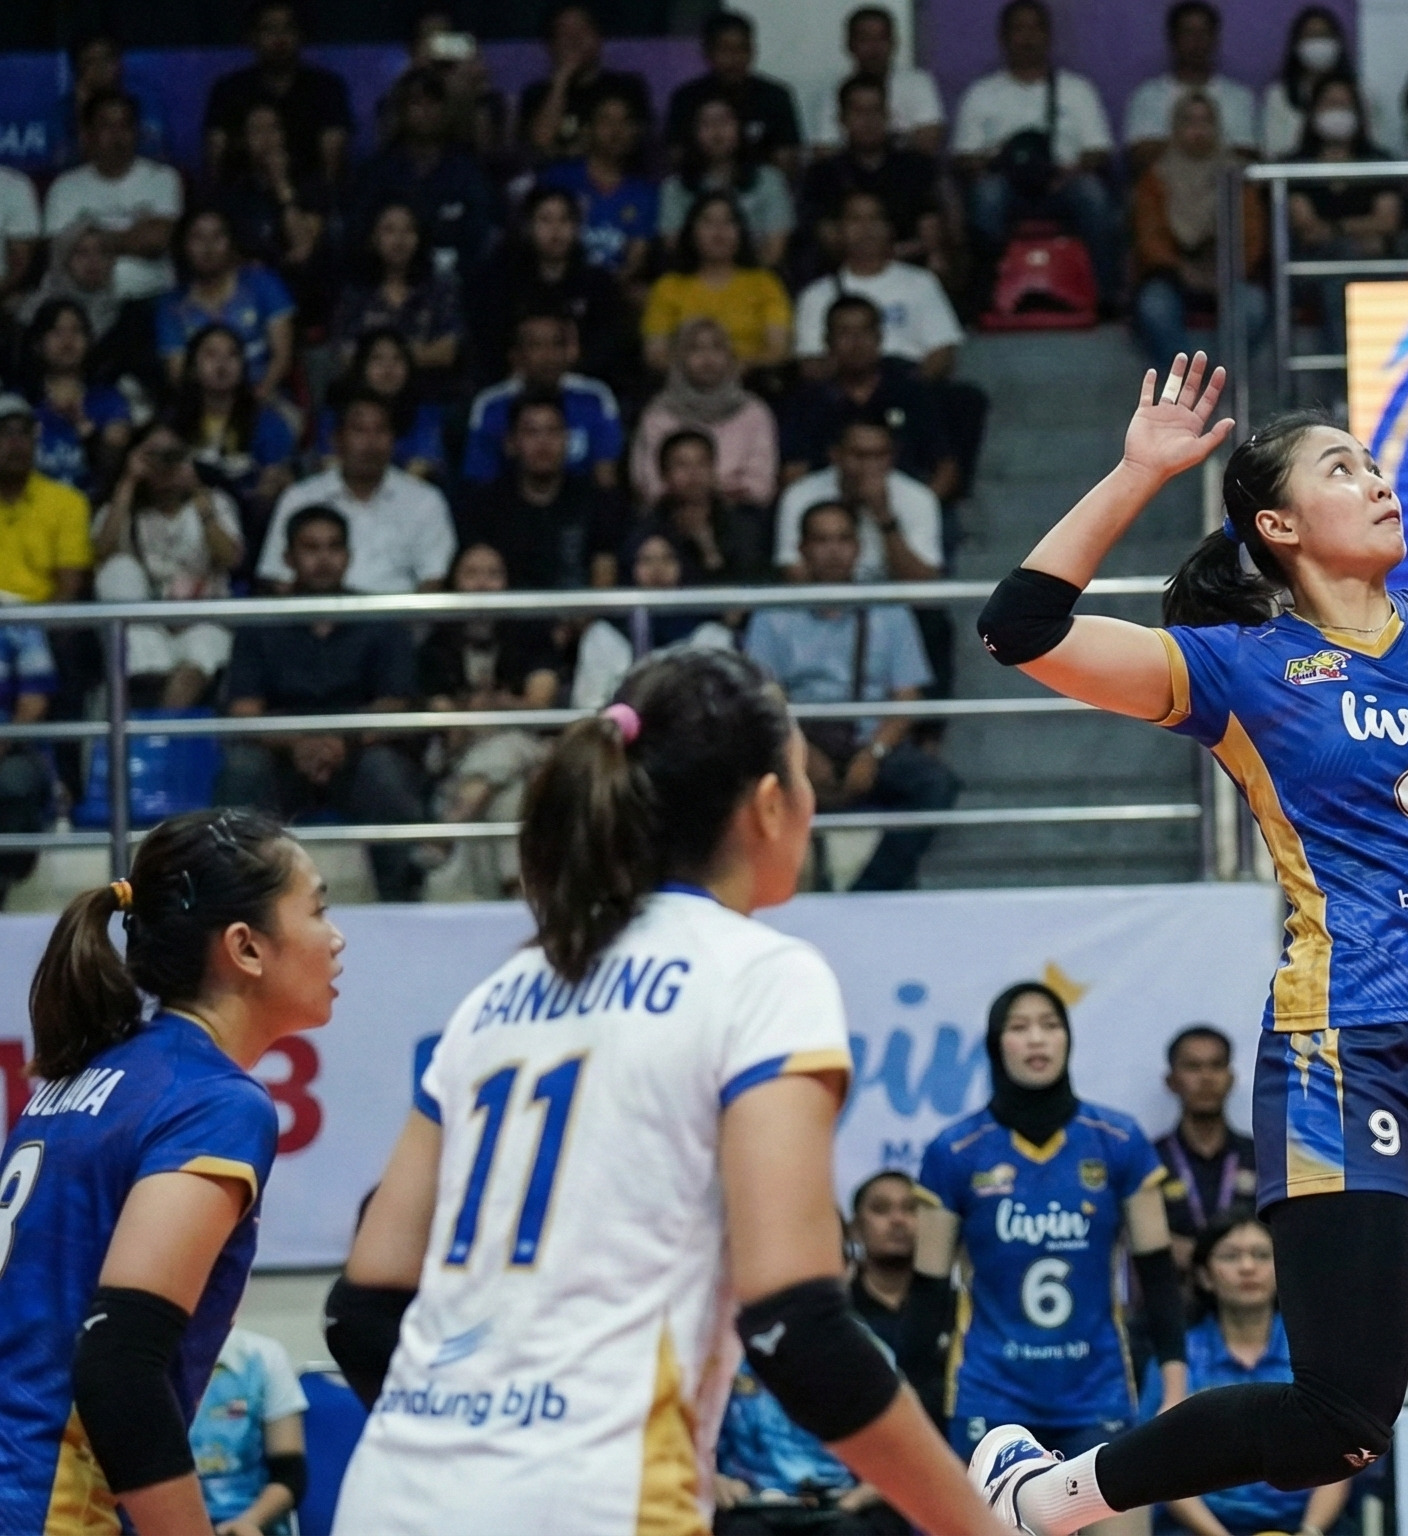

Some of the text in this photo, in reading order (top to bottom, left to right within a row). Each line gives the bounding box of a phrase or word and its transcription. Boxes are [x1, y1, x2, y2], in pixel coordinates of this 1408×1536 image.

[441, 1048, 590, 1272] 11
[1368, 1109, 1401, 1156] 9
[996, 1198, 1090, 1245] livin
[1022, 1257, 1074, 1329] 6
